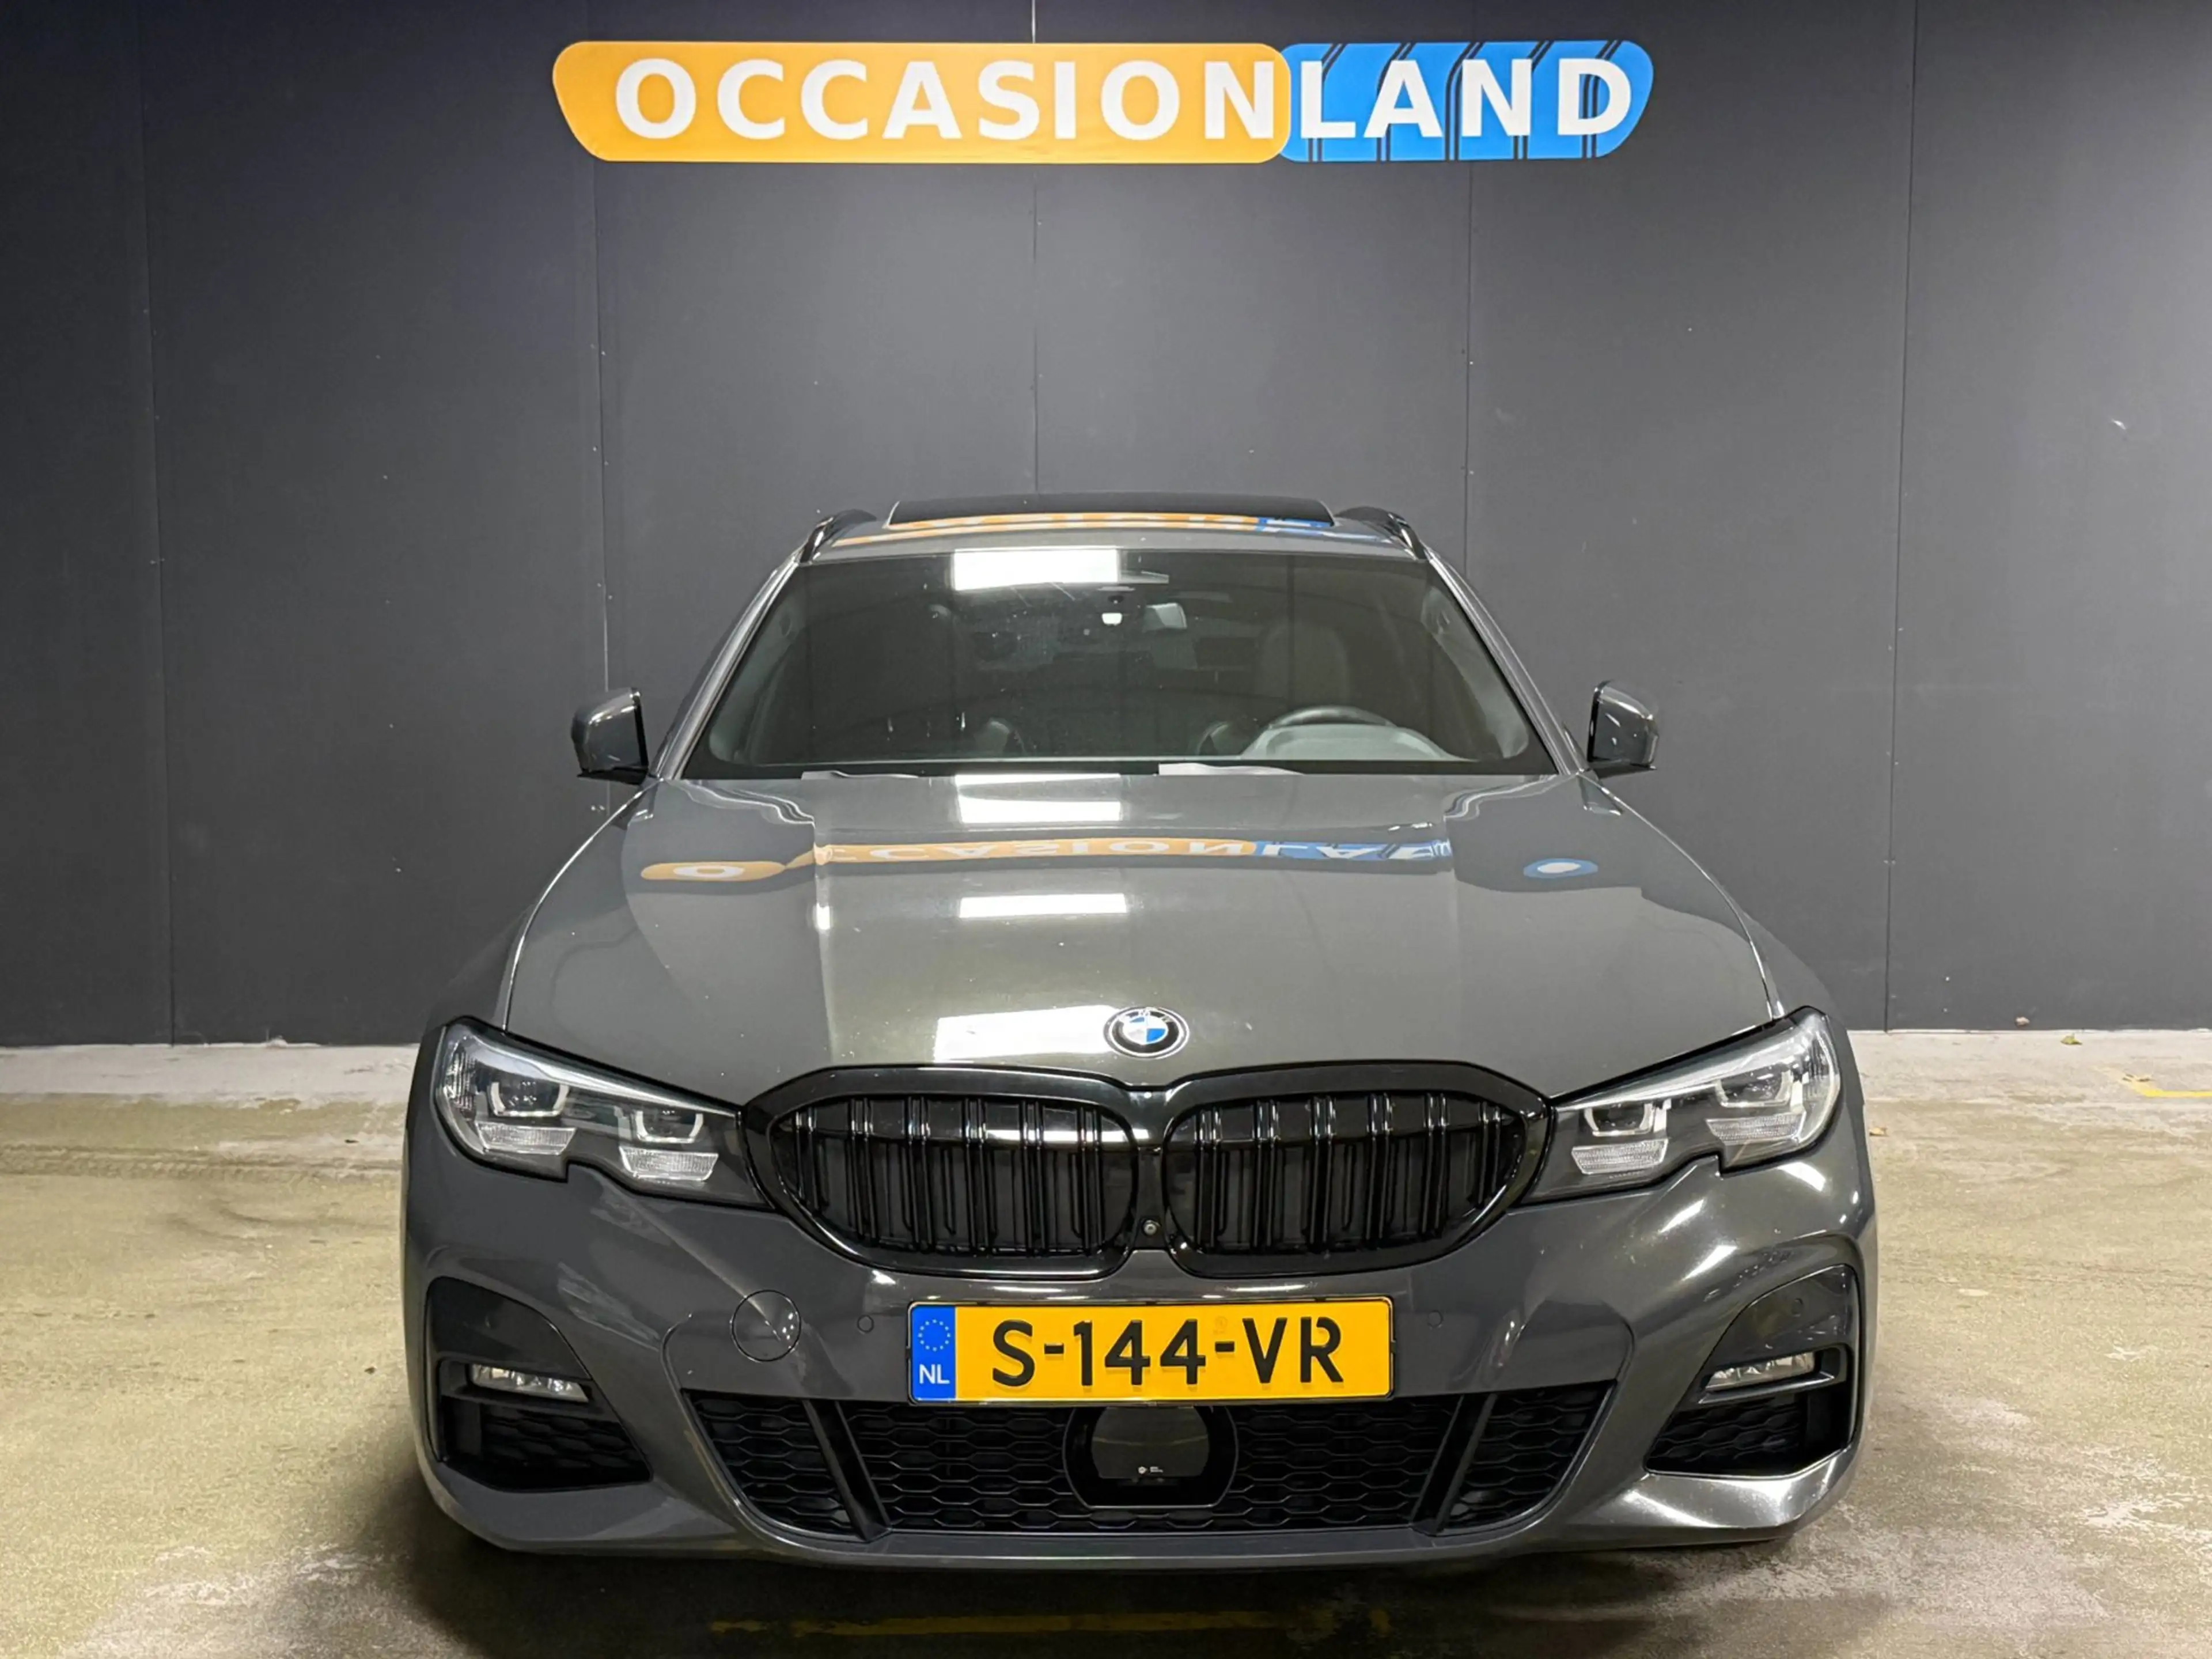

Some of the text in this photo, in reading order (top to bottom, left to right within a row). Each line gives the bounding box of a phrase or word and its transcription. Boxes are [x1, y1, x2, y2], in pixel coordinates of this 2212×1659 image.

[615, 58, 1633, 141] OCCASIONLAND
[919, 1363, 950, 1384] NL
[992, 1317, 1344, 1387] S-144-VR
